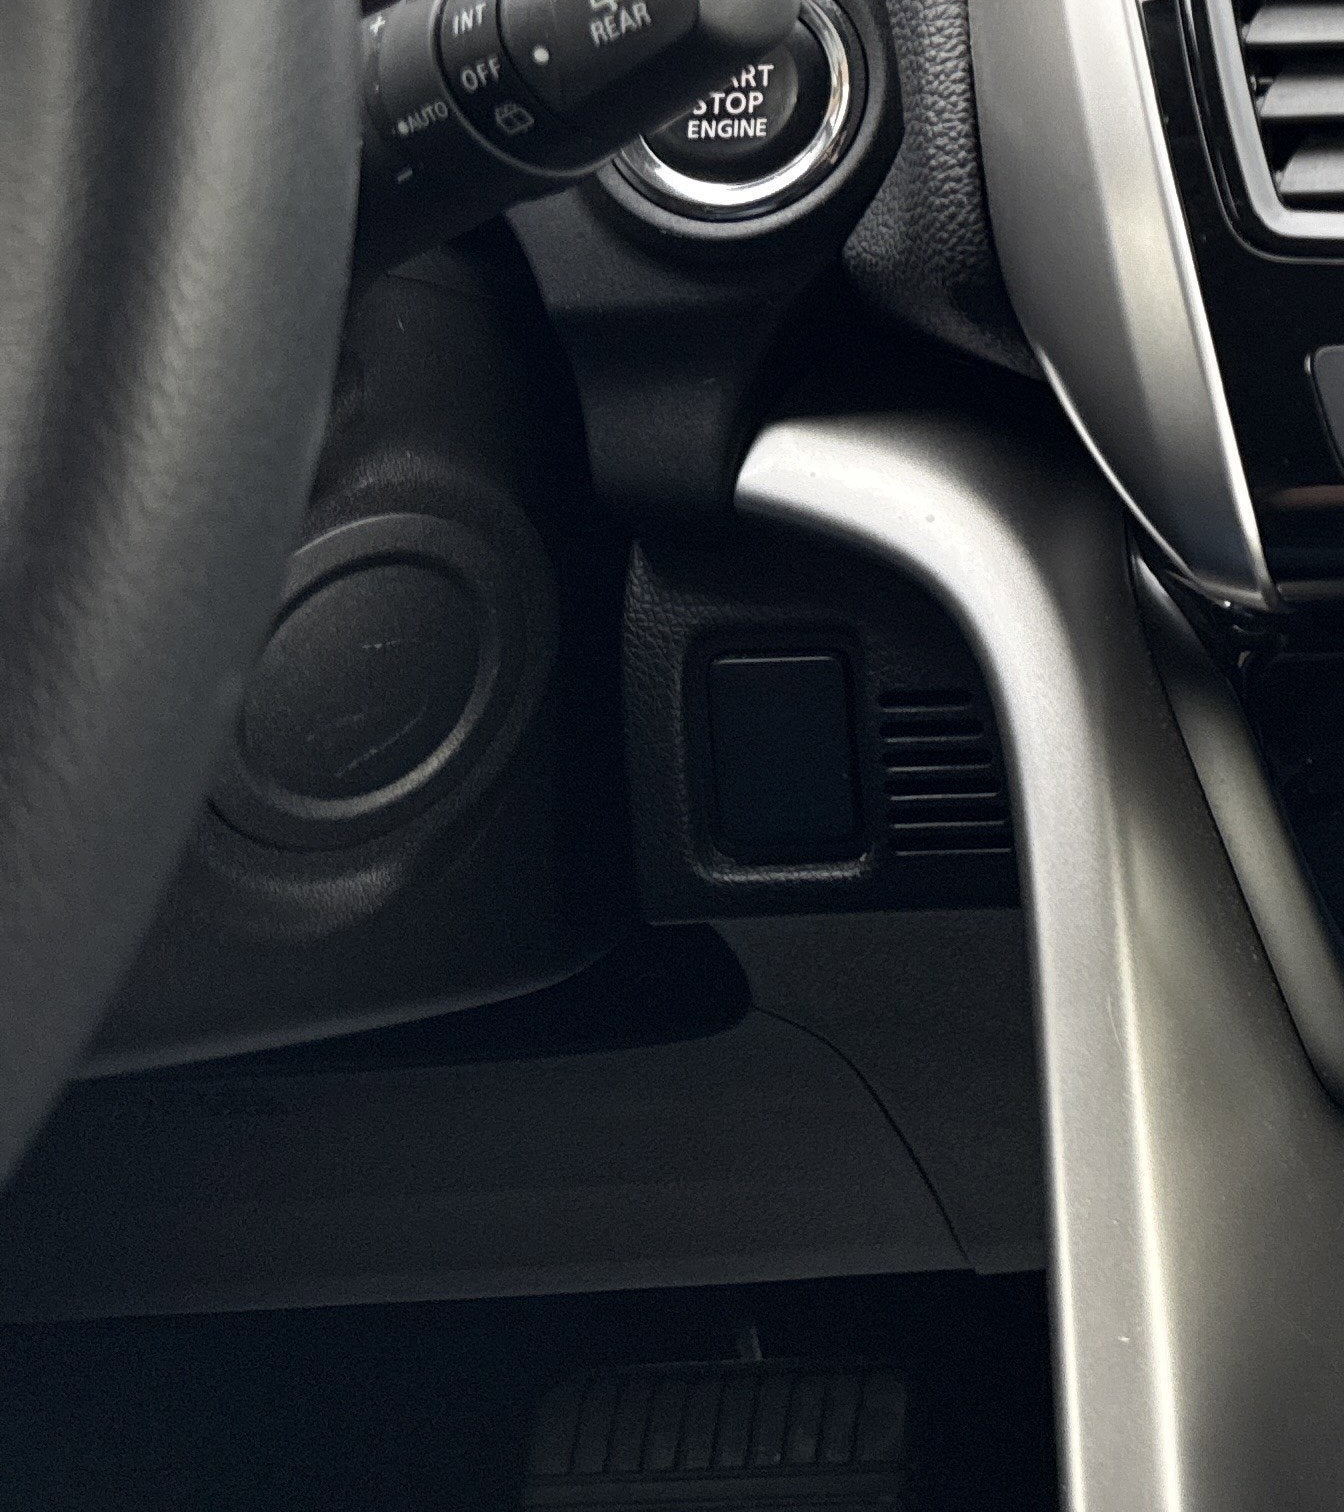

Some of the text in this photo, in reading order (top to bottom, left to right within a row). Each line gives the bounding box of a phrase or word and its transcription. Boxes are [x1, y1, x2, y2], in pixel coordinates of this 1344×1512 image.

[452, 2, 487, 35] INT
[461, 57, 501, 94] OFF
[407, 100, 449, 133] AUTO
[687, 117, 768, 140] ENGINE
